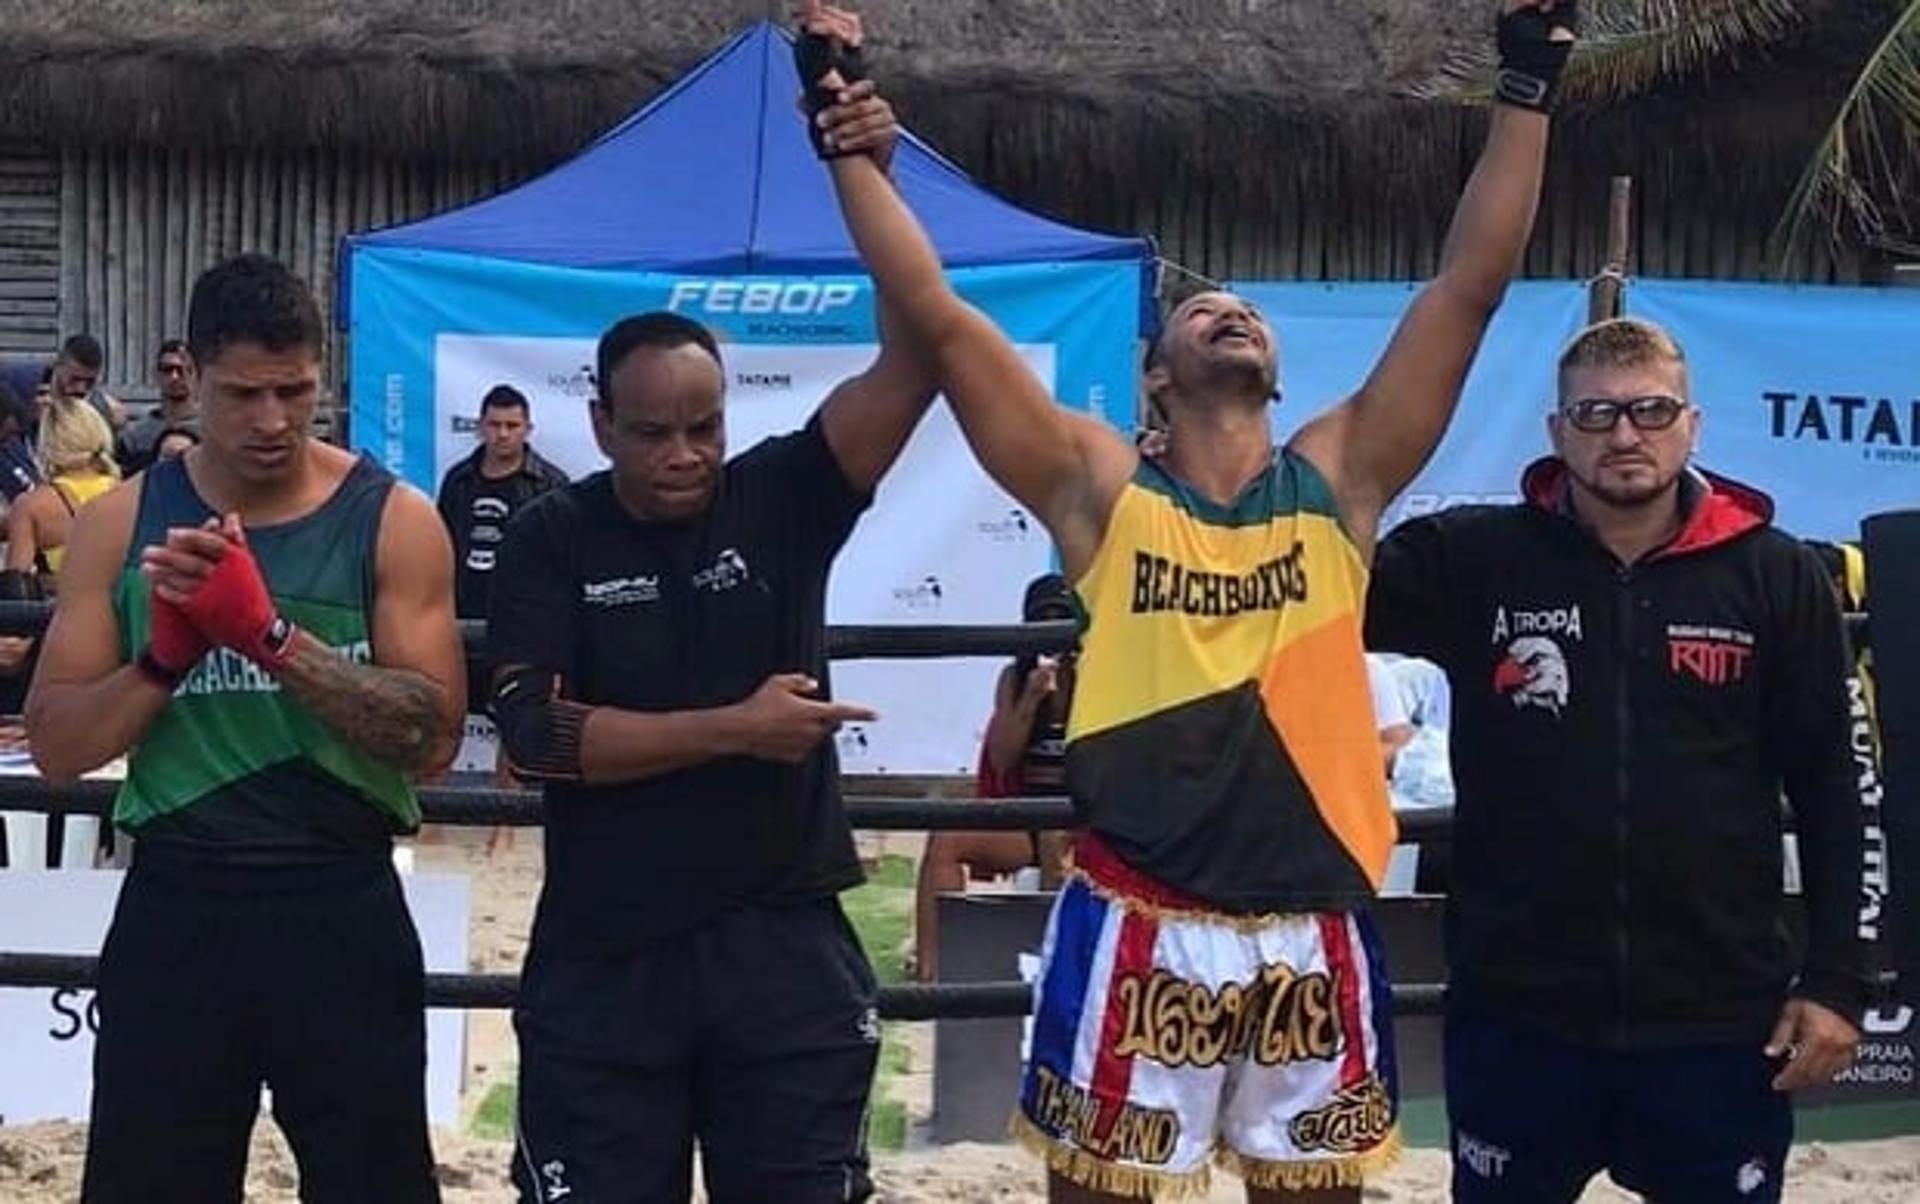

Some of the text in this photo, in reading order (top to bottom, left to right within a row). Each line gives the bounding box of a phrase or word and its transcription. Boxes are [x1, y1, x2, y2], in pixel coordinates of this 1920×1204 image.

[667, 281, 858, 314] FEBOP
[1492, 604, 1583, 645] A TROPA
[1856, 1043, 1914, 1061] PRAIA
